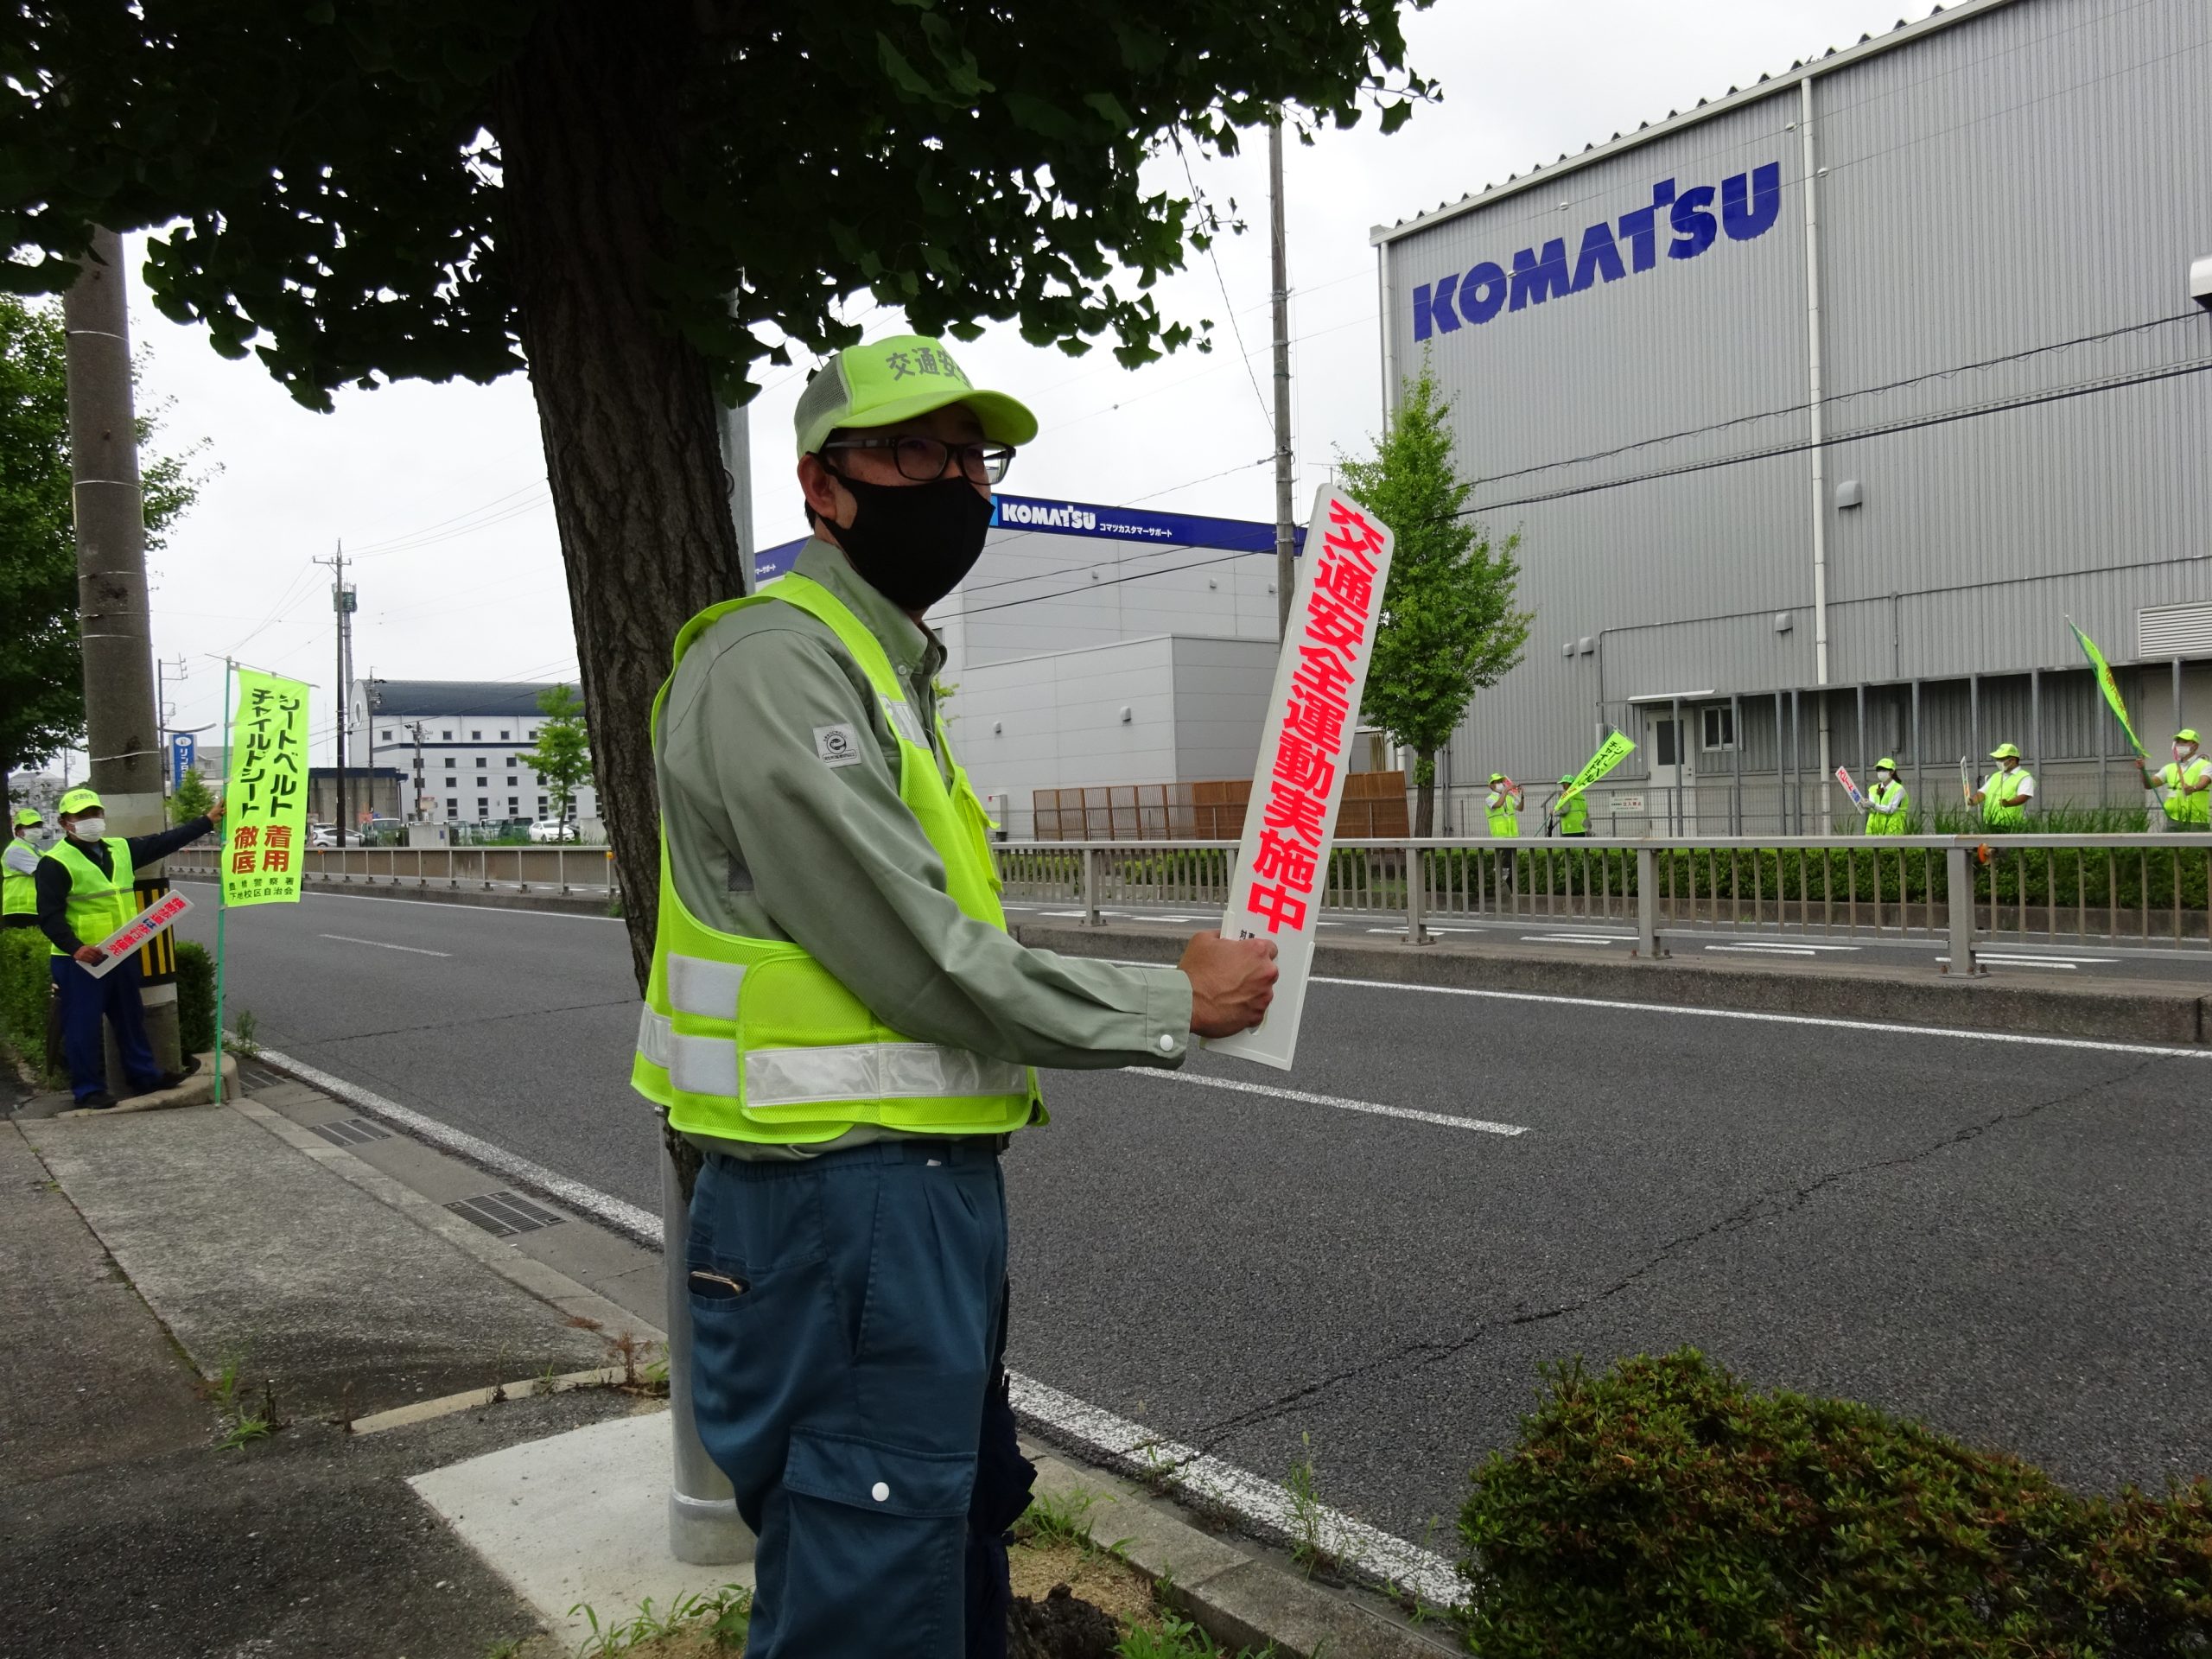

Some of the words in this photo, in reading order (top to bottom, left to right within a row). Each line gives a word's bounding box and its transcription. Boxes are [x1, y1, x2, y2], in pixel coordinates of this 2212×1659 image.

[1413, 161, 1780, 343] KOMATSU
[1001, 503, 1096, 530] KOMATSU
[1100, 523, 1173, 537] コマツカスタマーサポート
[240, 688, 274, 819] チャイルドシート
[270, 694, 300, 817] シートベルト
[1248, 498, 1385, 935] 交通安全運動実施中
[232, 825, 259, 874] 徹底
[262, 824, 292, 873] 着用
[229, 887, 294, 899] 下地校区自治会
